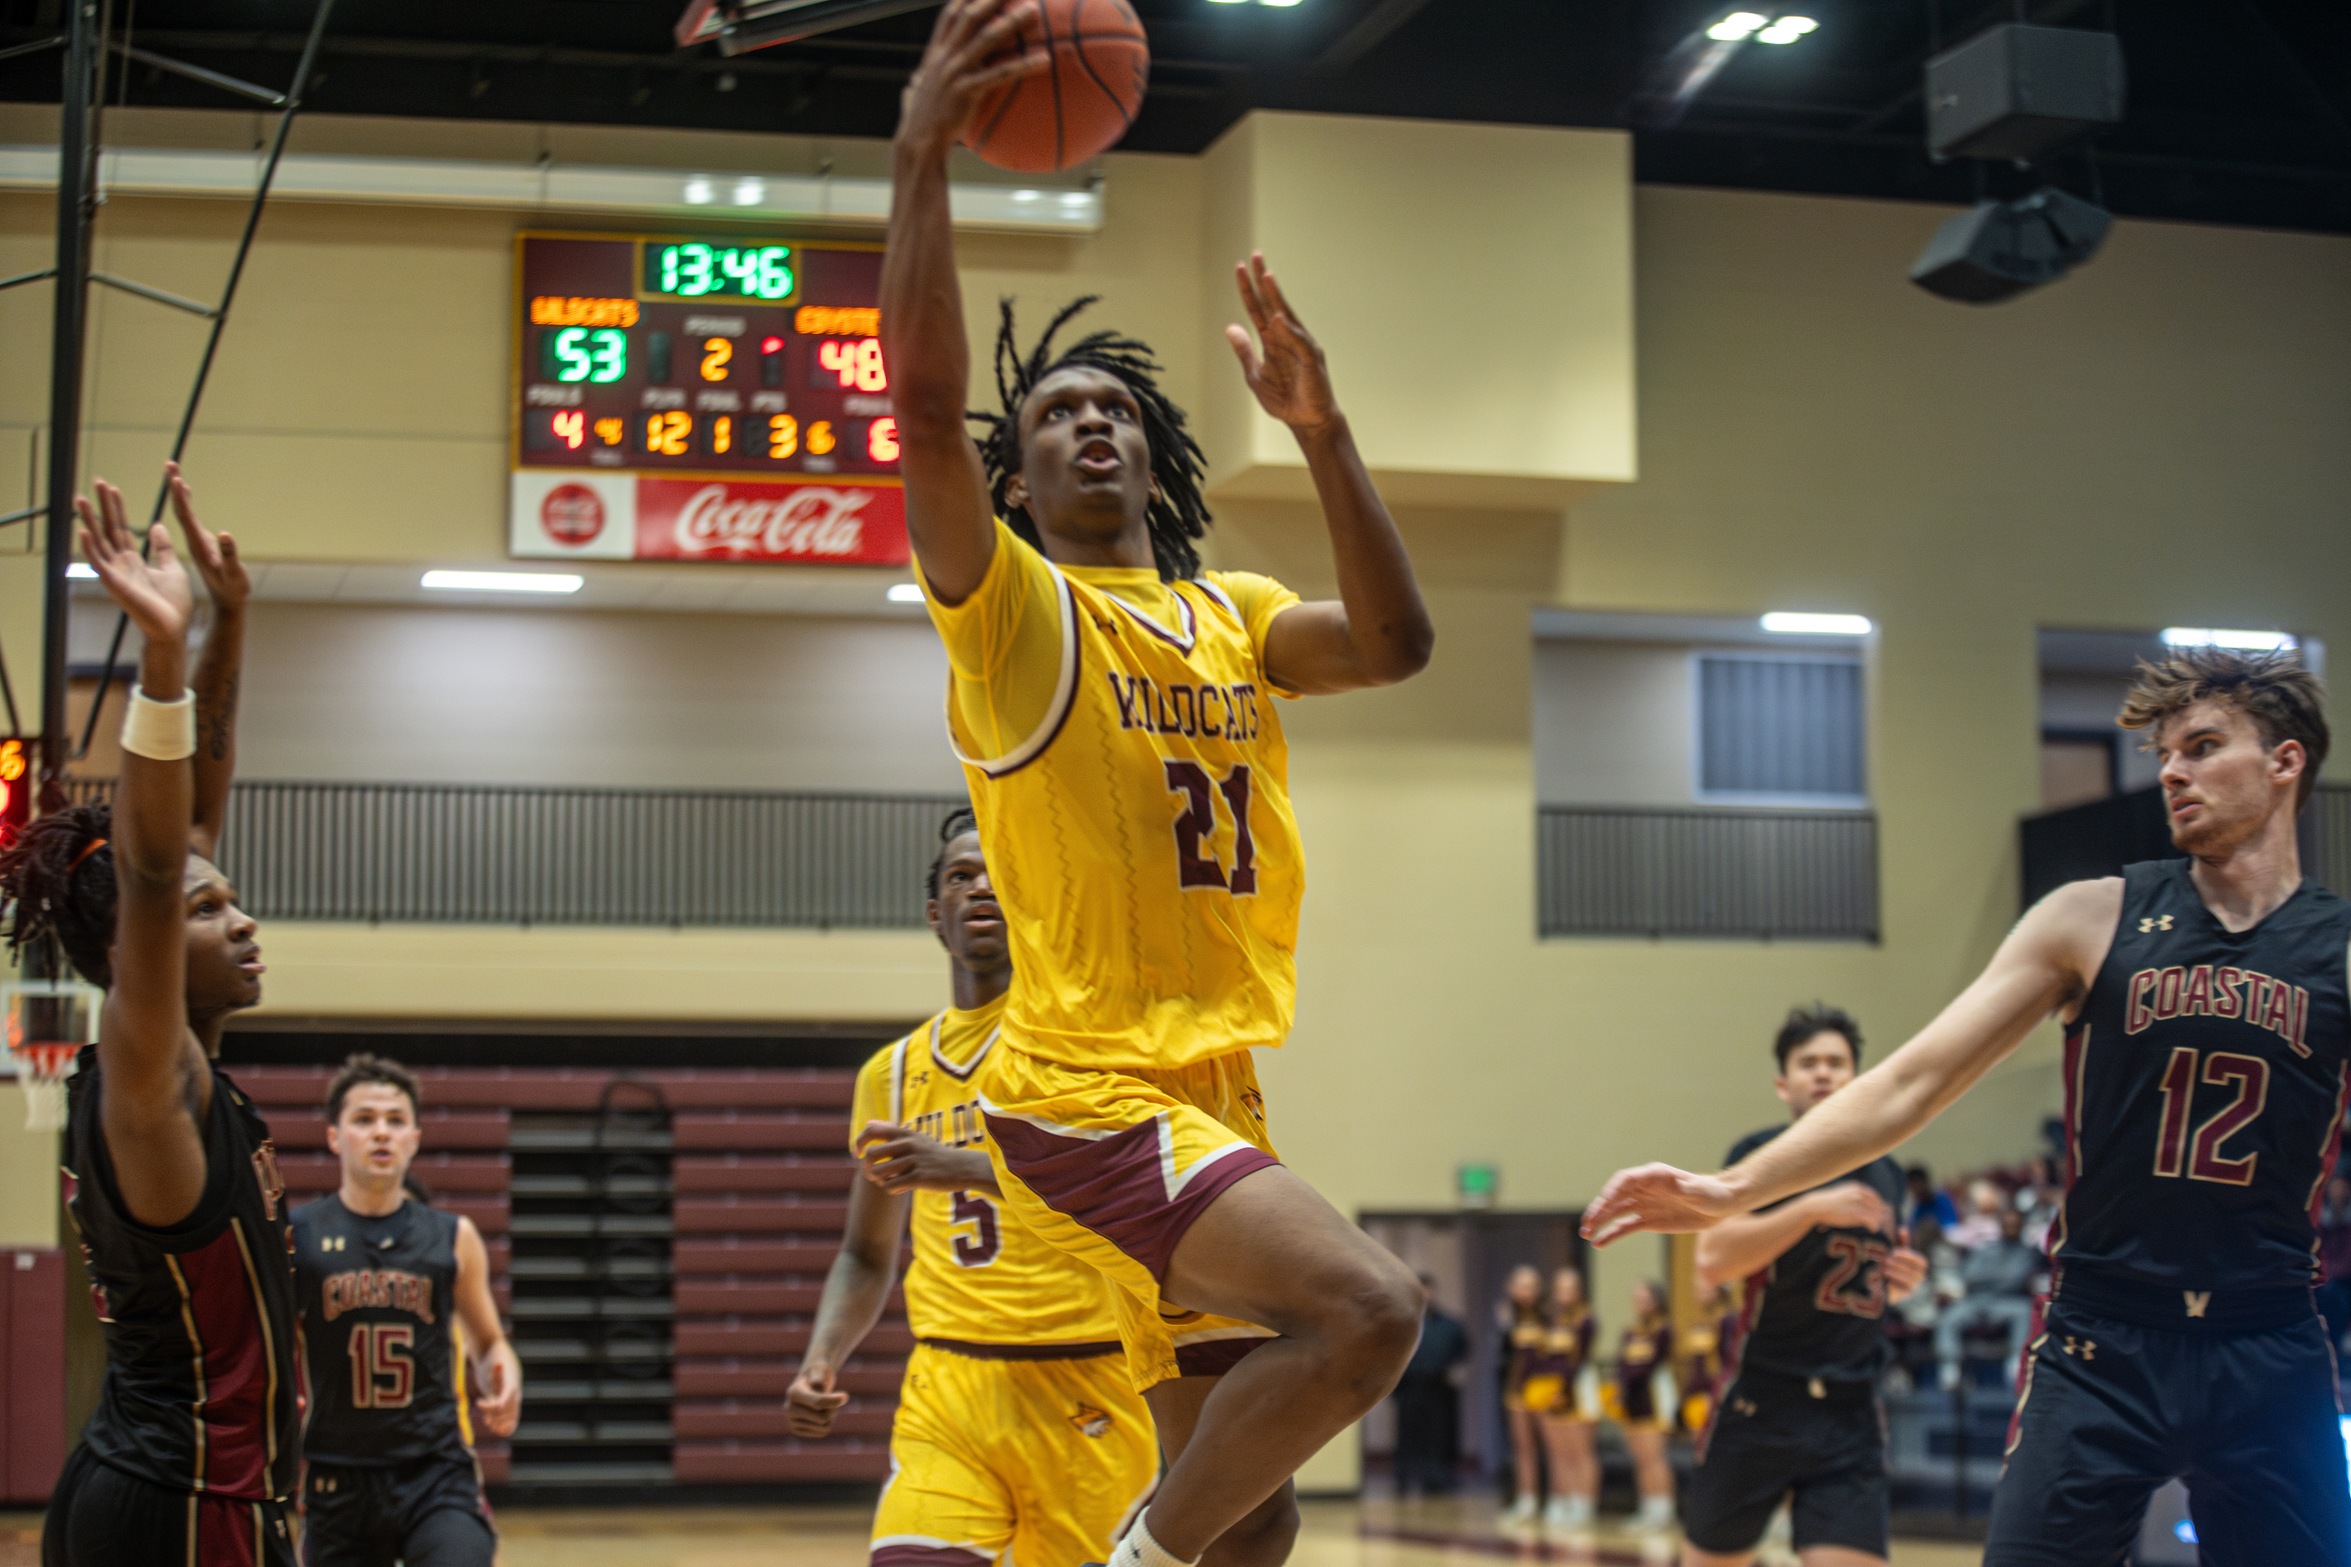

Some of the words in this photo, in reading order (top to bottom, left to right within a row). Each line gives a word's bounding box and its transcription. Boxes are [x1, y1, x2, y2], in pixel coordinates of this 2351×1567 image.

[661, 243, 793, 299] 13:46
[555, 326, 627, 383] 53
[700, 337, 733, 382] 2
[819, 338, 888, 392] 48
[552, 409, 585, 449] 4
[646, 411, 693, 456] 12
[713, 416, 731, 454] 1
[768, 414, 798, 459] 3
[1107, 671, 1260, 743] WILDCATS
[1163, 757, 1259, 898] 21
[2124, 964, 2313, 1060] COASTAL
[2152, 1046, 2271, 1187] 12
[950, 1189, 1003, 1268] 5
[322, 1267, 437, 1326] COASTAL
[1815, 1235, 1888, 1320] 23
[347, 1322, 415, 1409] 15
